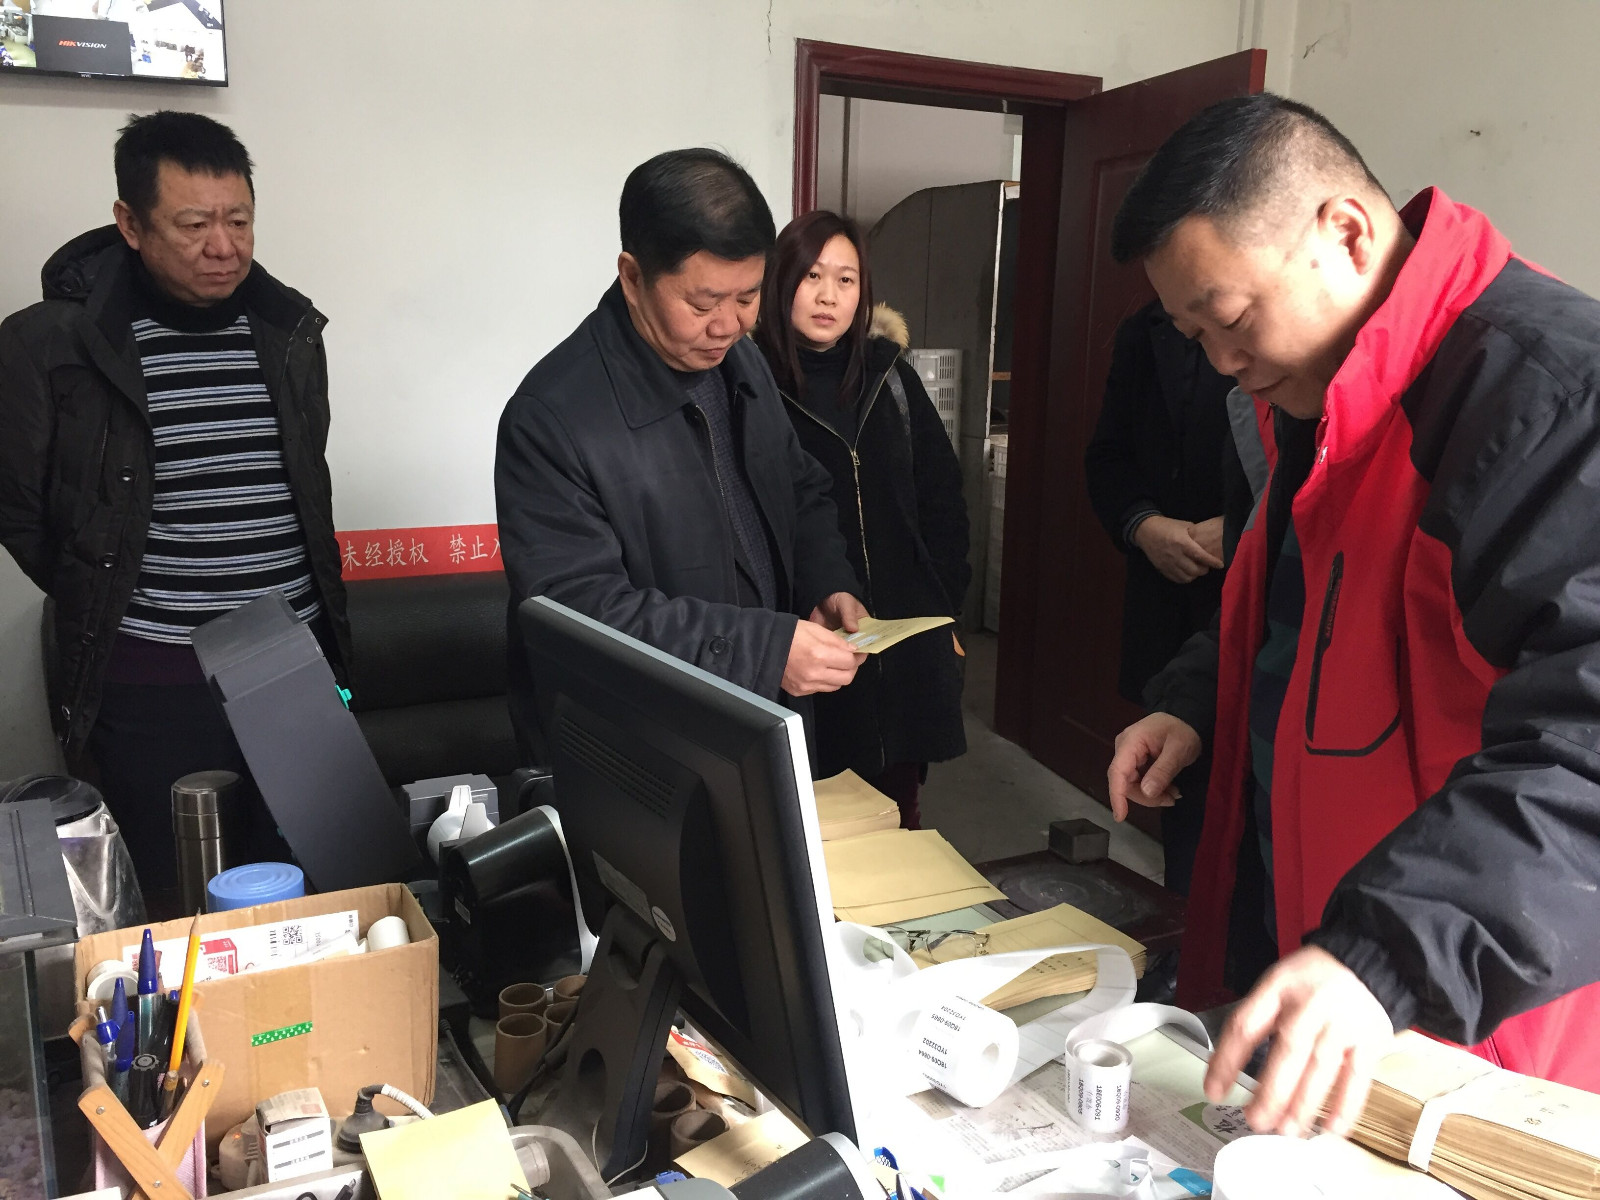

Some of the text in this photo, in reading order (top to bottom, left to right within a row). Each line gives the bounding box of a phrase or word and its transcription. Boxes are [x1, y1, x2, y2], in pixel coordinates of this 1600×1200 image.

[58, 40, 107, 48] HIKVISION
[342, 538, 429, 571] 未经授权
